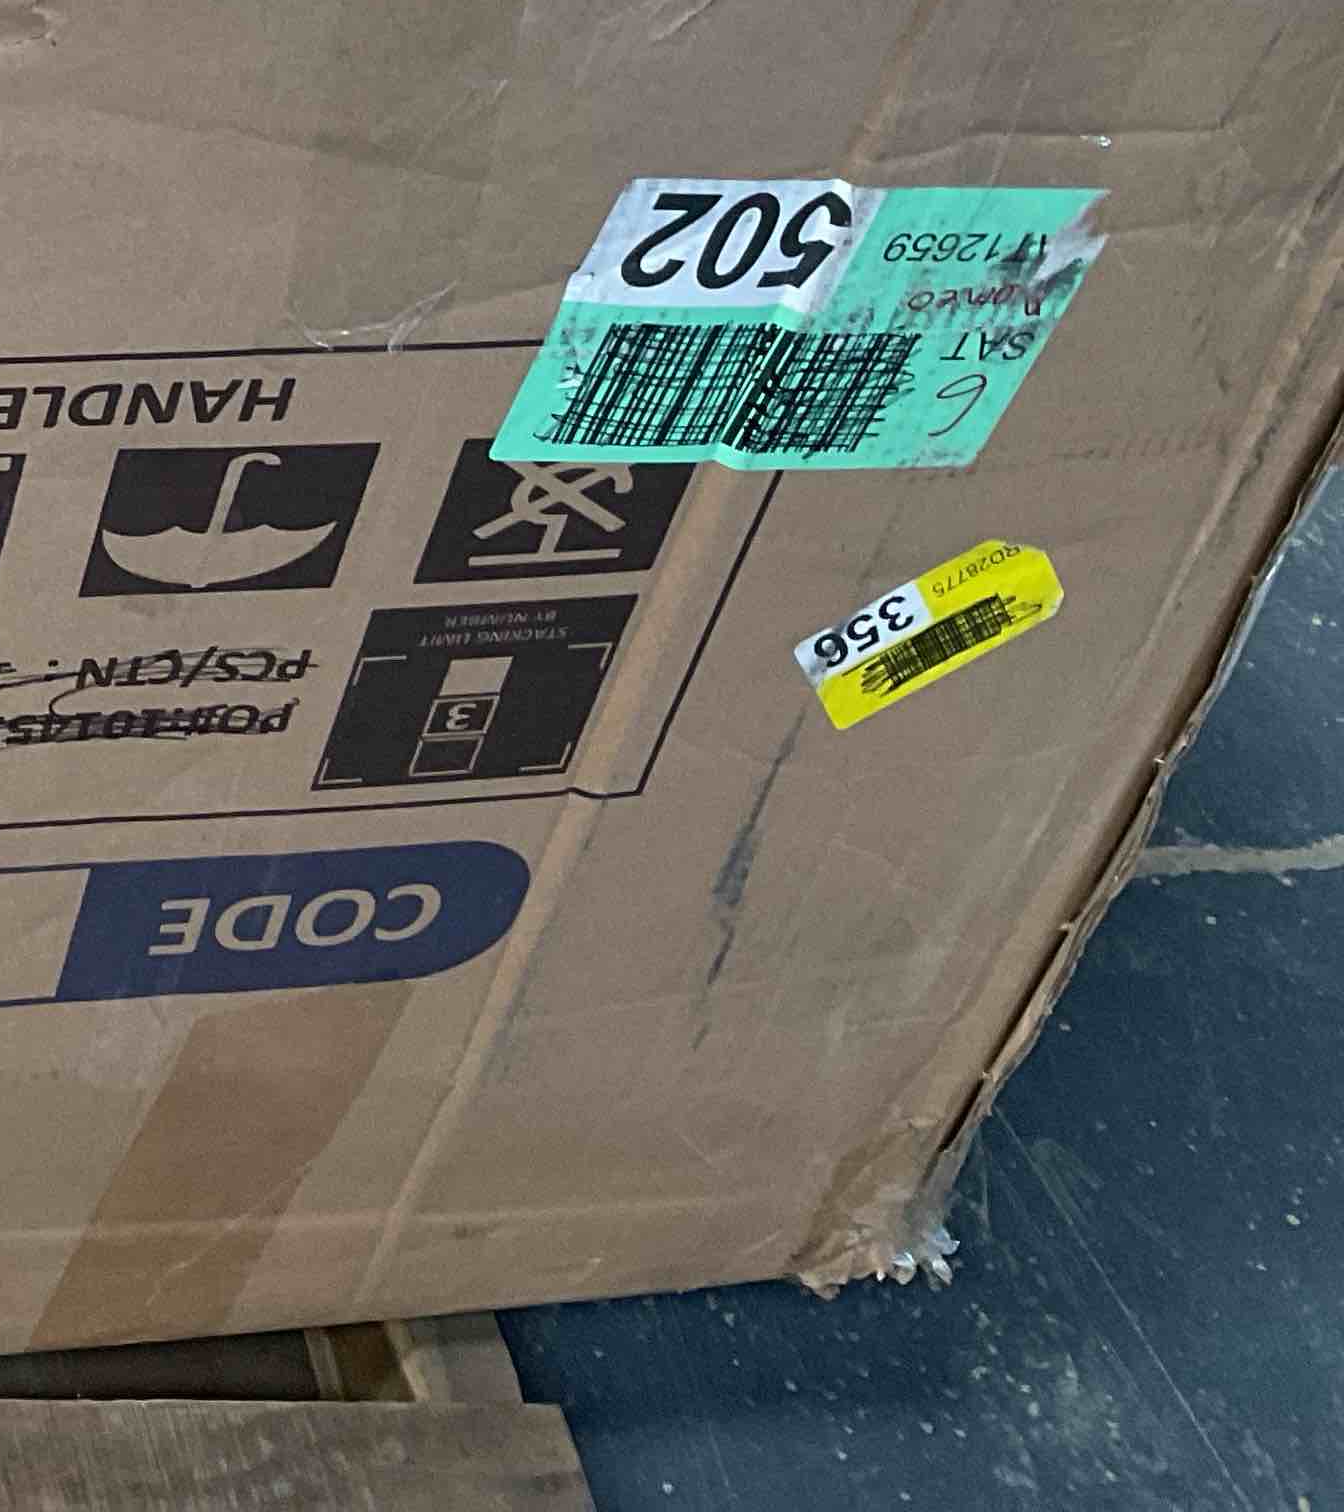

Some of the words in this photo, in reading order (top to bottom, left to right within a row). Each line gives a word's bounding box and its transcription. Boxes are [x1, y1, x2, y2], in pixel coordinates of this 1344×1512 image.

[621, 192, 852, 289] 502
[939, 331, 1035, 361] SAT
[415, 630, 472, 648] LIMIT
[476, 626, 568, 645] STACKING
[813, 596, 914, 667] 356
[444, 702, 477, 731] 3
[148, 882, 442, 956] CODE
